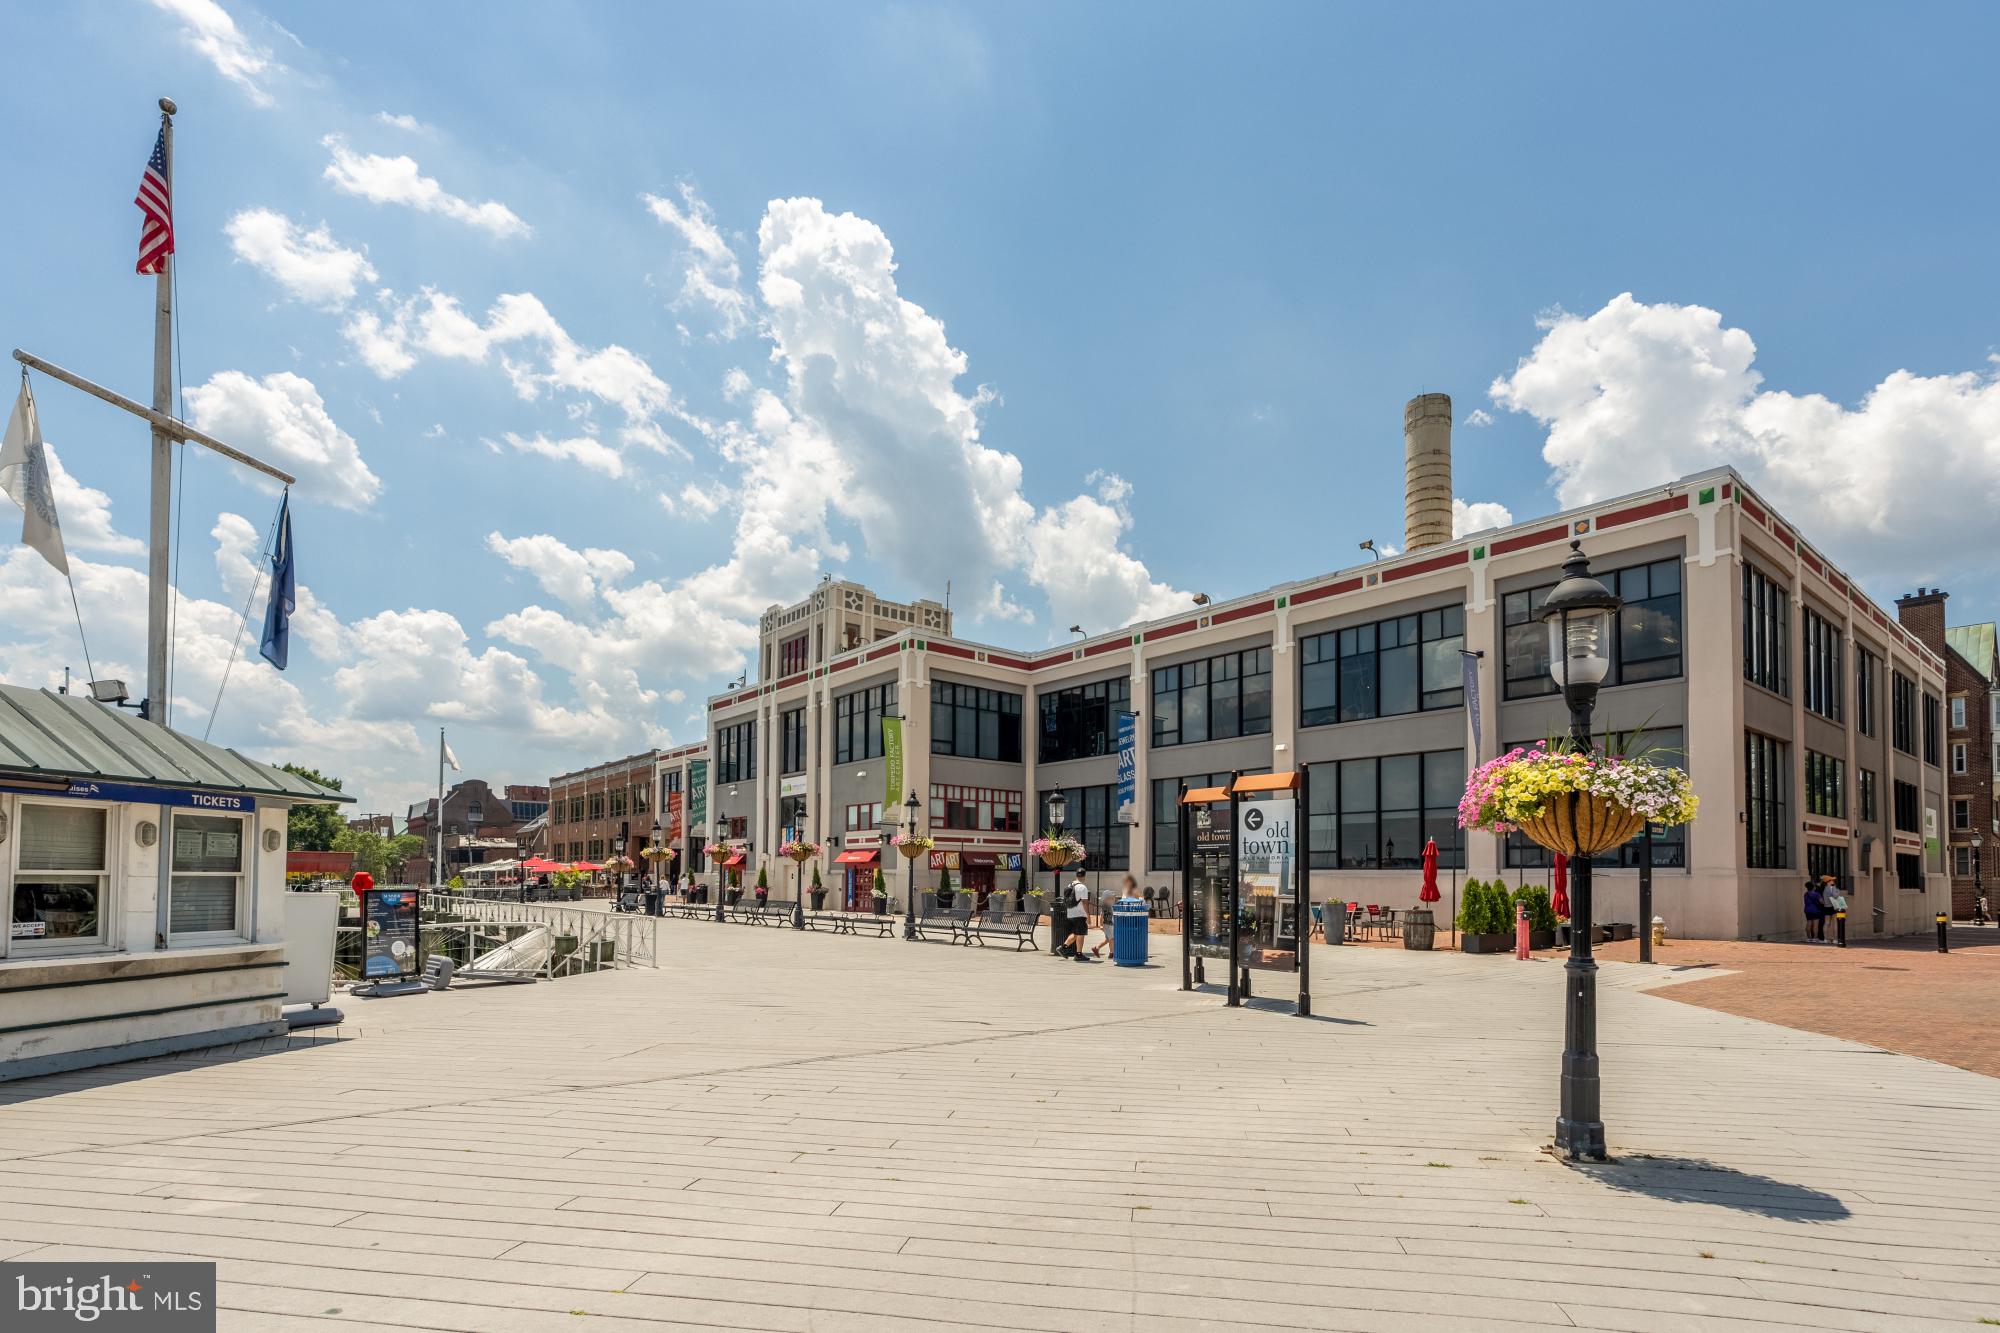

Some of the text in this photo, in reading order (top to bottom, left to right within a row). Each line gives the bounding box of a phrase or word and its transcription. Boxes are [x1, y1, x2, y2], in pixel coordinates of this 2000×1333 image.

[1118, 747, 1135, 769] ART
[692, 784, 707, 801] ART
[192, 795, 240, 808] TICKETS
[1197, 832, 1230, 842] old town
[1266, 821, 1289, 838] old
[1243, 837, 1290, 855] town
[931, 852, 945, 868] ART
[946, 853, 960, 867] ART
[1008, 854, 1021, 870] ART
